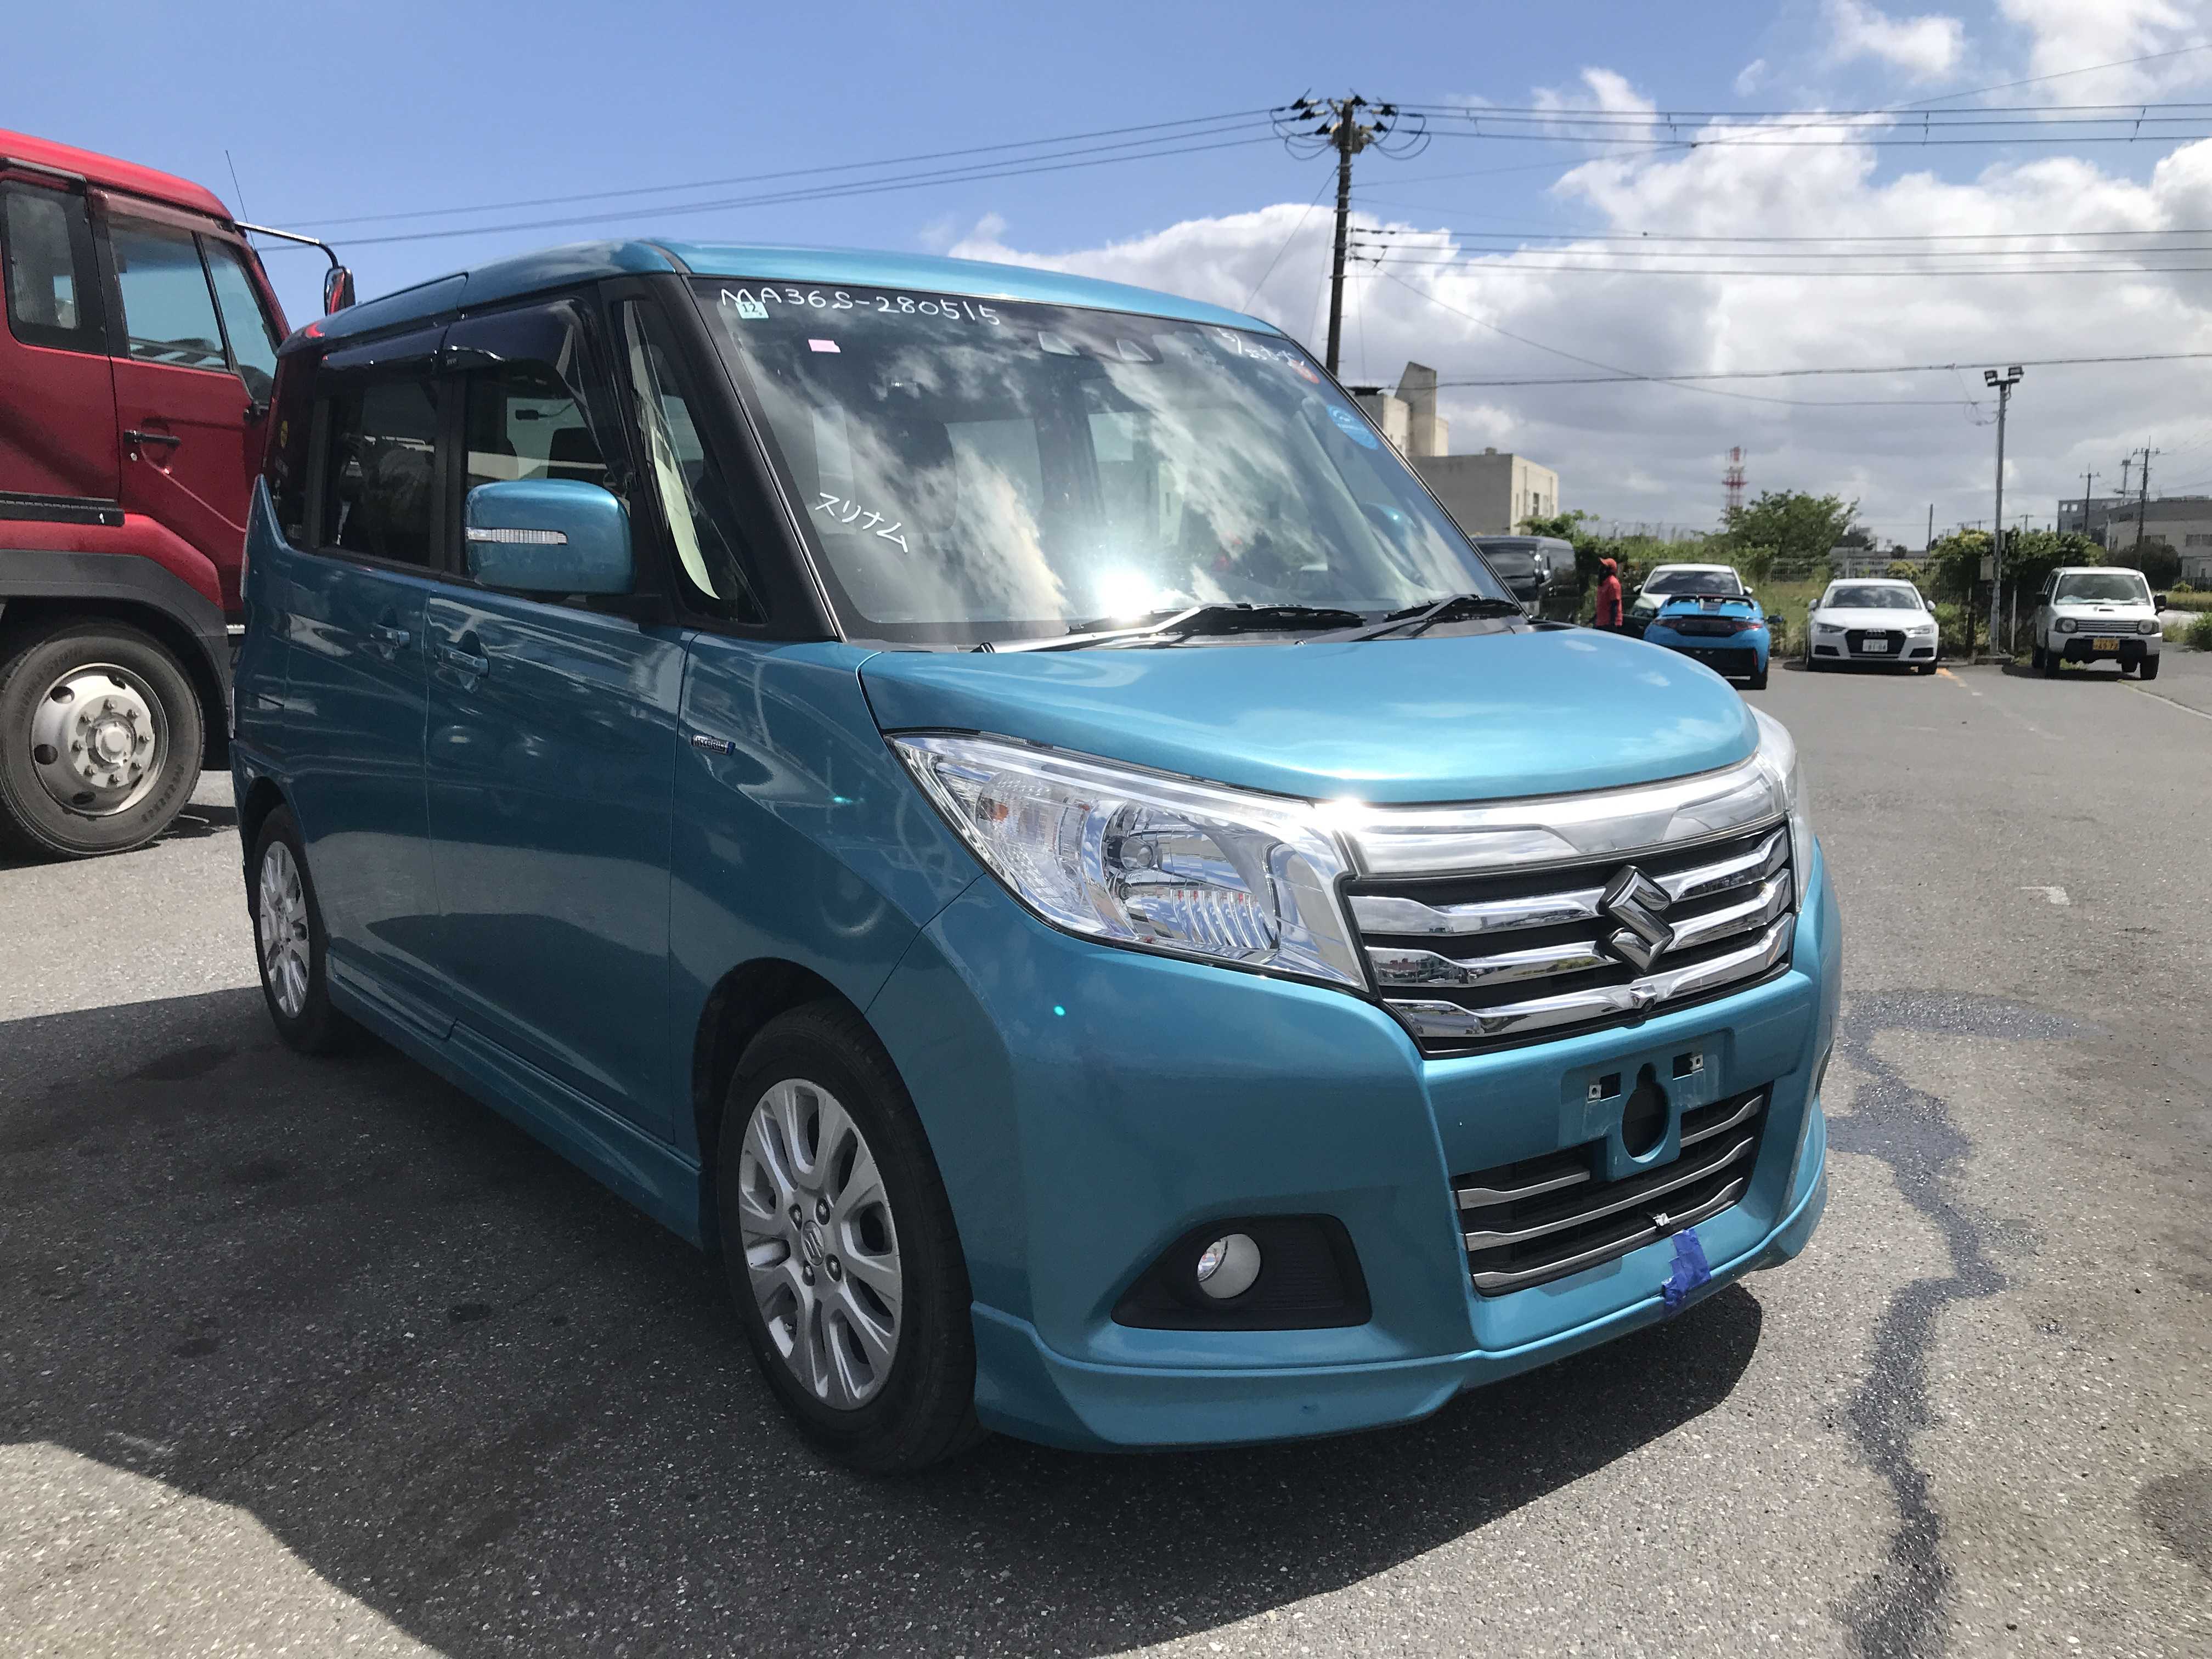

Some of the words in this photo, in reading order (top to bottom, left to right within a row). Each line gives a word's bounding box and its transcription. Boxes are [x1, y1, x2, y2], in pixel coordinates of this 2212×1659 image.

[742, 303, 759, 313] 12
[815, 492, 909, 554] スリナム
